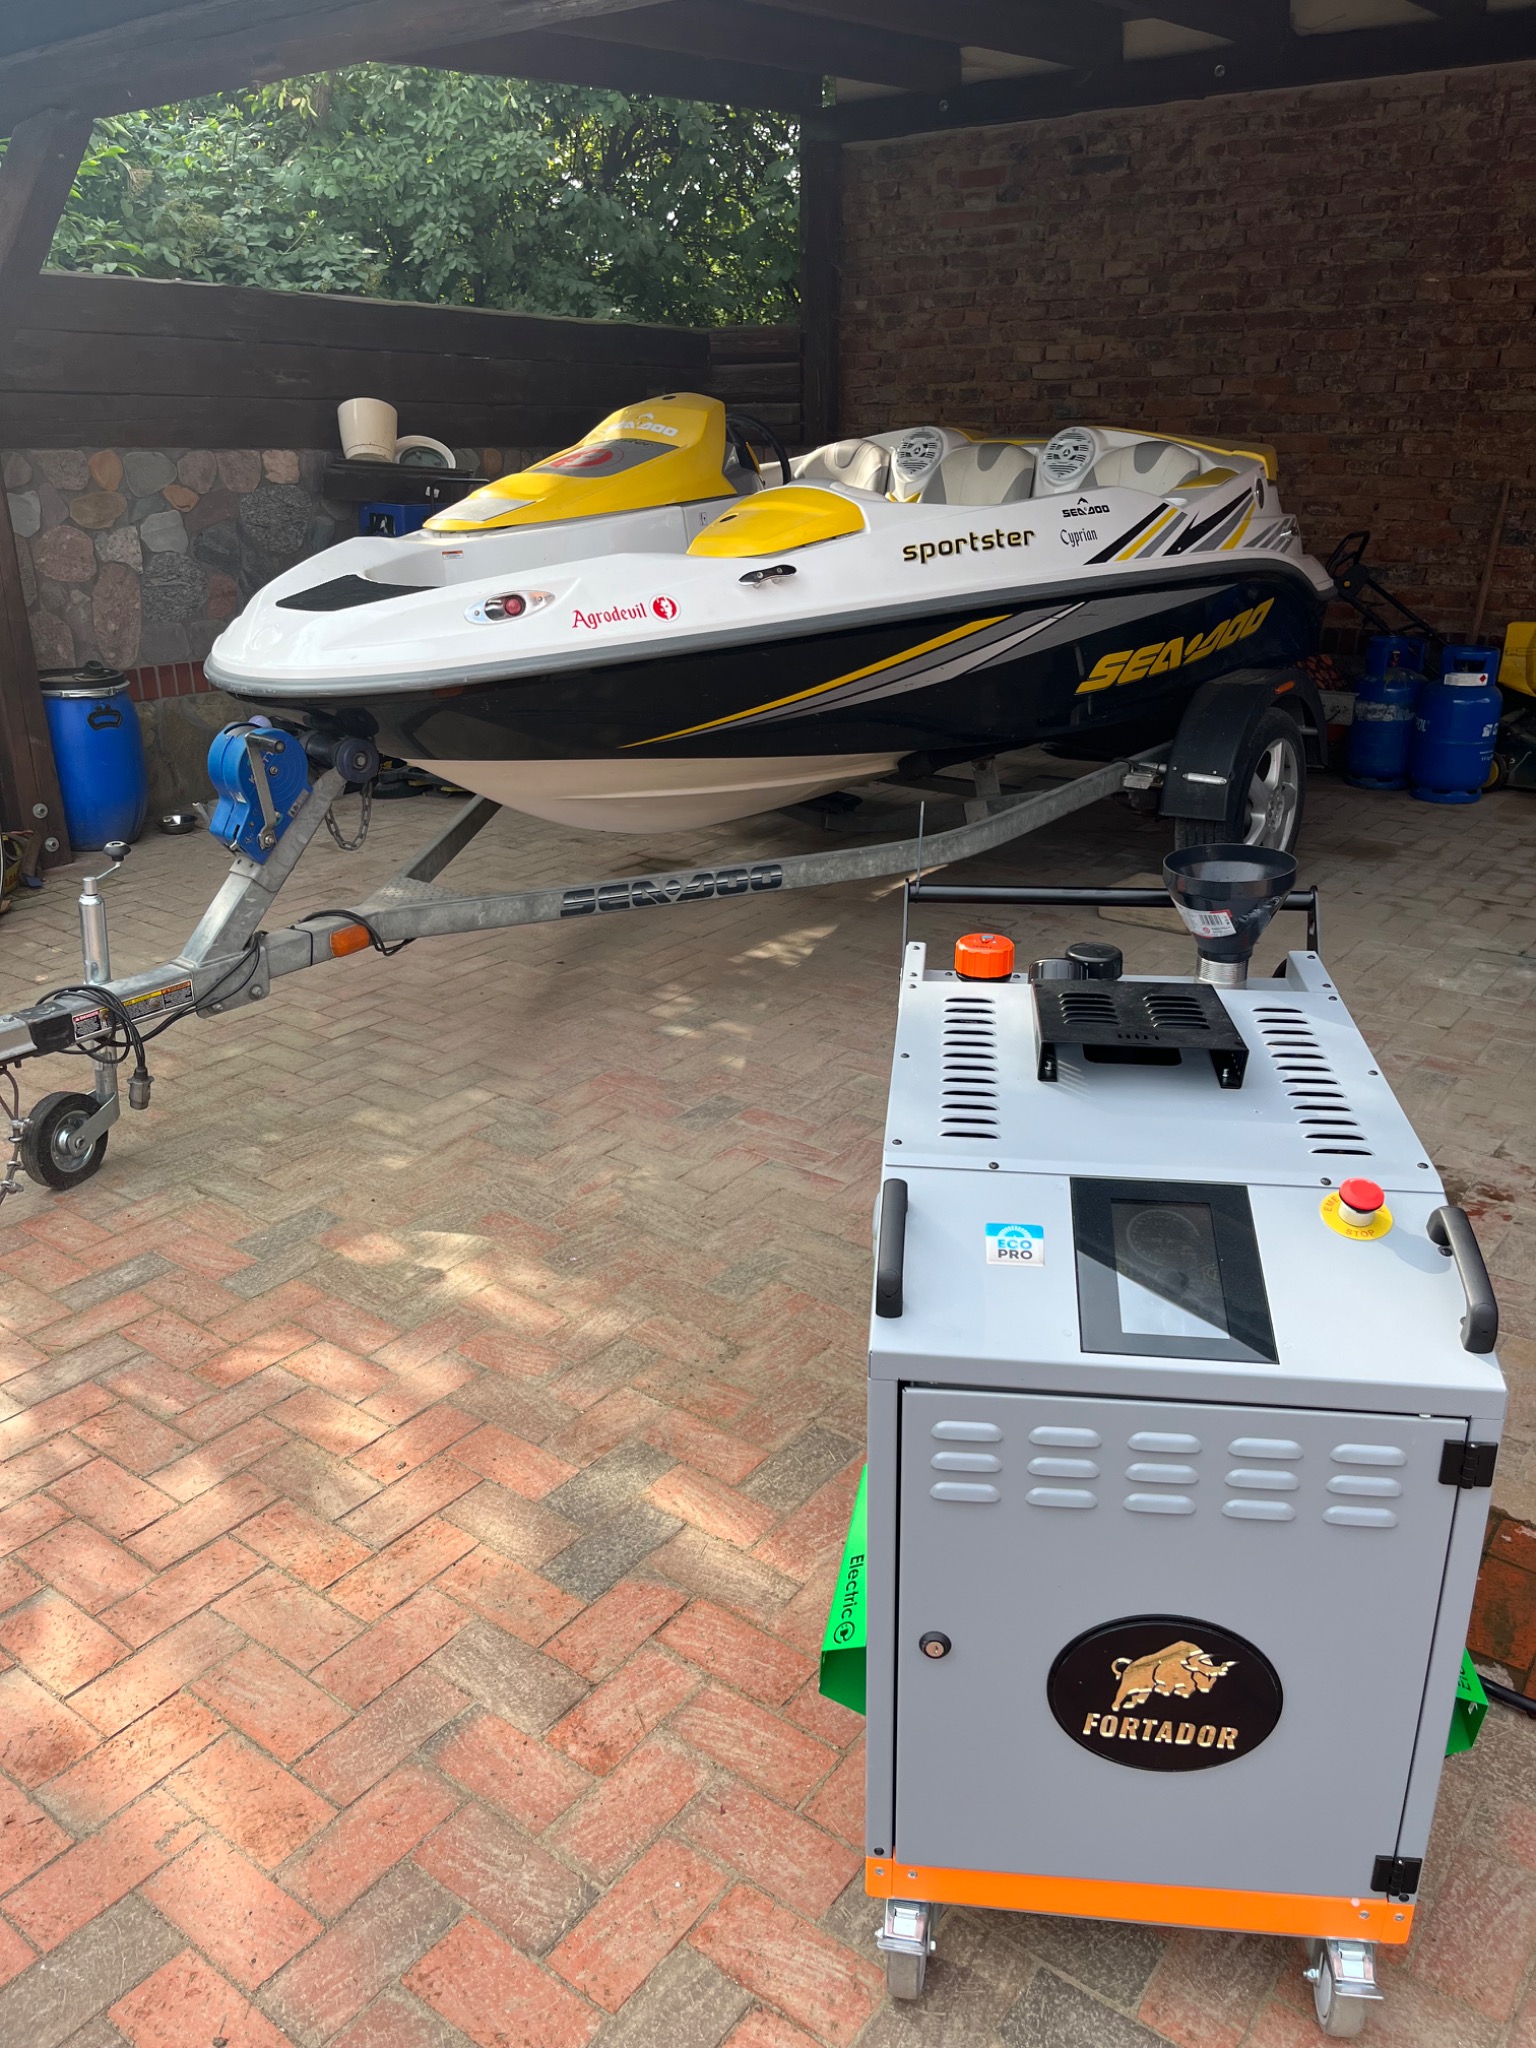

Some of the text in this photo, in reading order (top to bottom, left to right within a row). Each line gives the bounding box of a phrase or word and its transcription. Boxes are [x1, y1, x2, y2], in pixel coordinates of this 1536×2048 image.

[902, 529, 1036, 564] sportster
[1060, 528, 1098, 548] Cyprian
[572, 602, 648, 630] Agrodevil
[997, 1238, 1032, 1250] ECO
[1345, 1228, 1375, 1238] STOP
[997, 1249, 1033, 1260] PRO
[841, 1553, 865, 1620] Electric
[1082, 1712, 1239, 1750] FORTADOR
